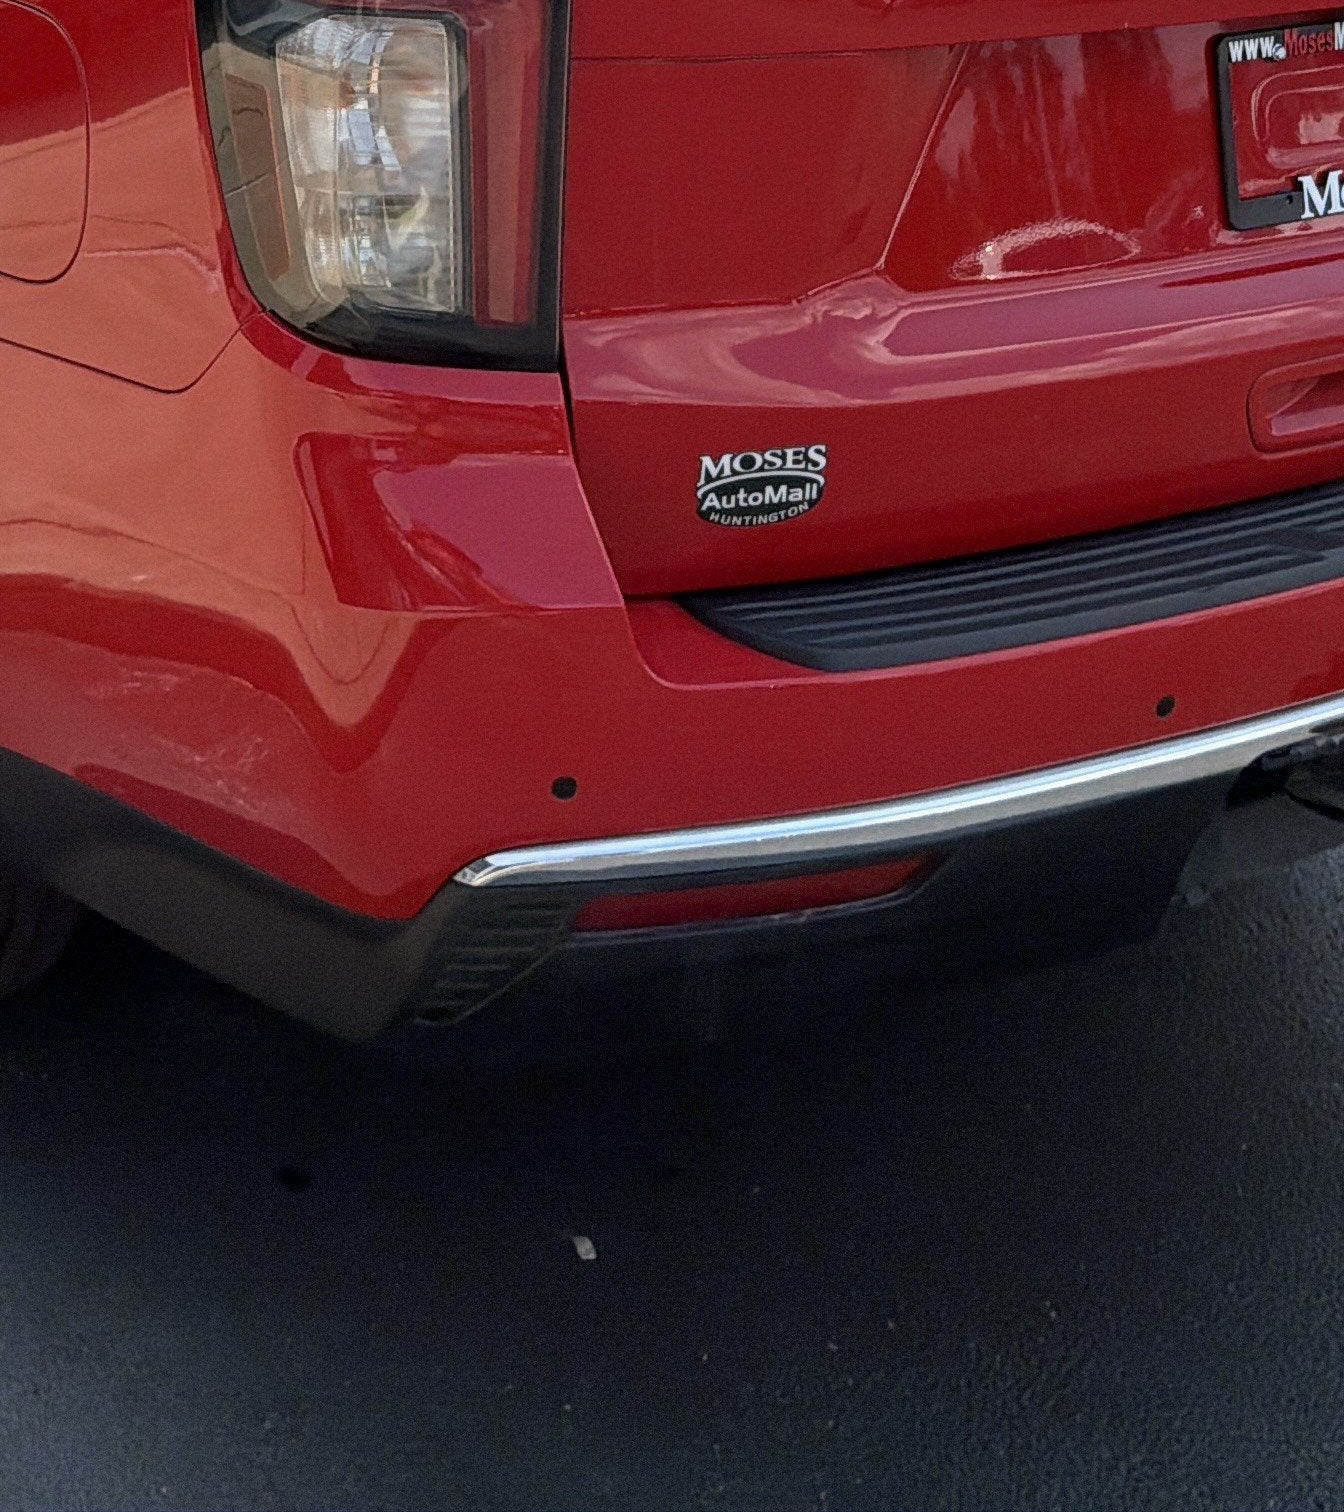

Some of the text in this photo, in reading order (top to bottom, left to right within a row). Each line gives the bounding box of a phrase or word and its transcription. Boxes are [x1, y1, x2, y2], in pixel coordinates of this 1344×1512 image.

[696, 444, 828, 488] MOSES
[700, 483, 819, 512] AutoMall
[708, 502, 810, 526] HUNTINGTON
